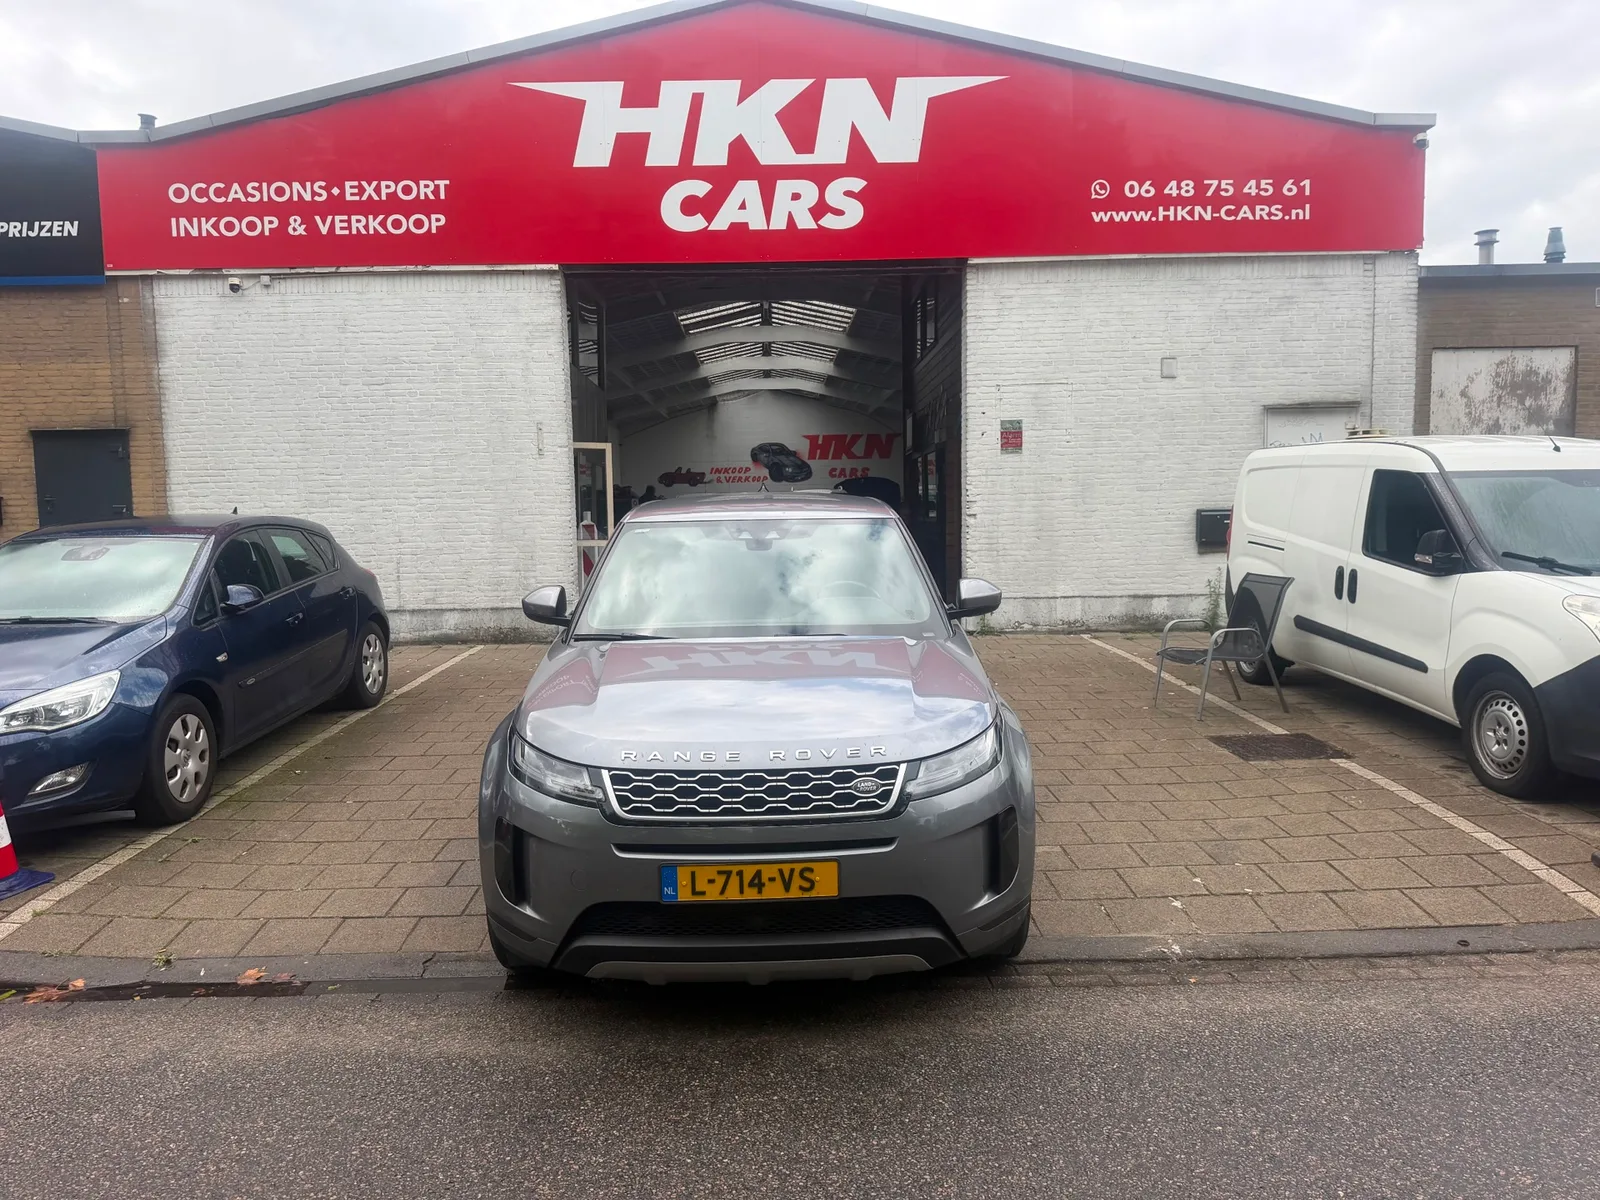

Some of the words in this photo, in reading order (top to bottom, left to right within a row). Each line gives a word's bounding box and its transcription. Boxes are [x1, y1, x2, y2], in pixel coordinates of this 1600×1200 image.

[507, 75, 1010, 168] HKN
[168, 181, 328, 204] OCCASIONS
[345, 179, 450, 201] EXPORT
[1124, 180, 1156, 197] 06
[1163, 180, 1195, 197] 48
[1203, 179, 1235, 197] 75
[1242, 179, 1274, 196] 45
[1282, 179, 1311, 196] 61
[660, 177, 868, 233] CARS
[1091, 204, 1311, 222] www.HKN-CARS.nl
[170, 217, 279, 237] INKOOP
[287, 216, 307, 235] &
[314, 213, 446, 236] VERKOOP
[802, 433, 901, 460] HKN
[710, 467, 751, 475] INKOOP
[829, 467, 870, 478] CARS
[621, 750, 741, 762] RANGE
[769, 746, 887, 761] ROVER
[664, 887, 676, 895] NL
[691, 867, 815, 895] L-714-VS
